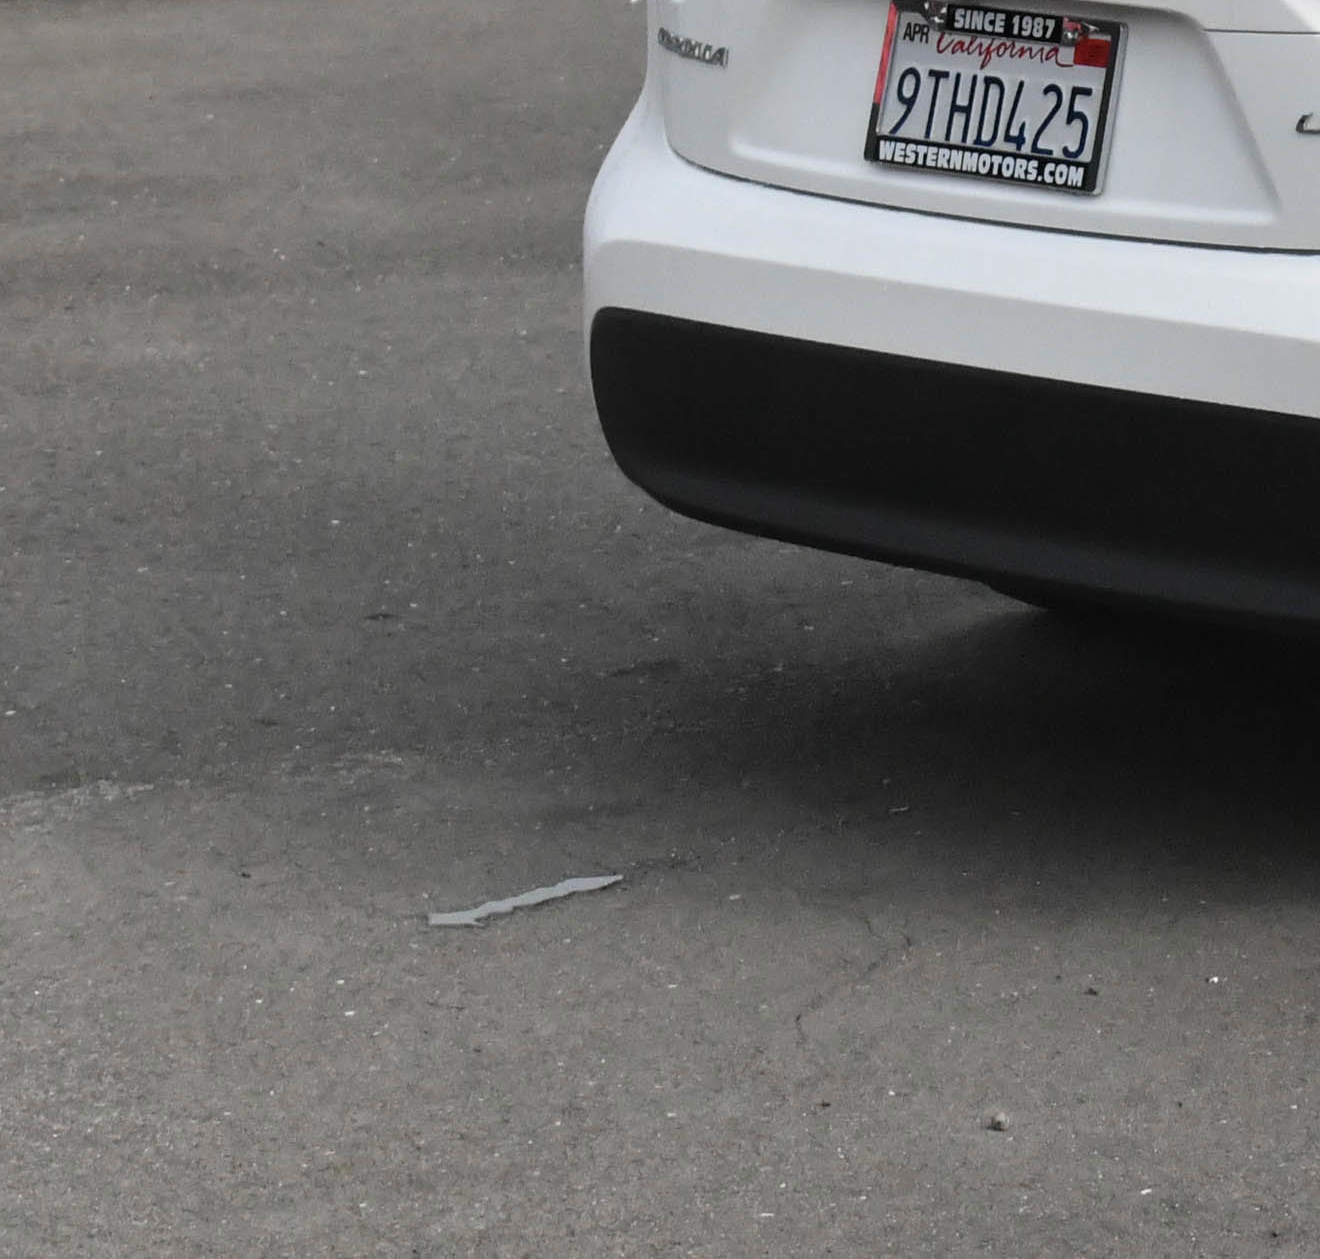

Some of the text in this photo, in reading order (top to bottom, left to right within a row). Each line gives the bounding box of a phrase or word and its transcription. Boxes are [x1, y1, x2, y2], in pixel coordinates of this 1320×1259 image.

[903, 22, 930, 44] APR
[953, 8, 1056, 39] SINCE 1987
[935, 31, 1074, 70] California
[889, 66, 1093, 160] 9THD425
[878, 139, 1085, 188] WESTERNMOTORS.COM
